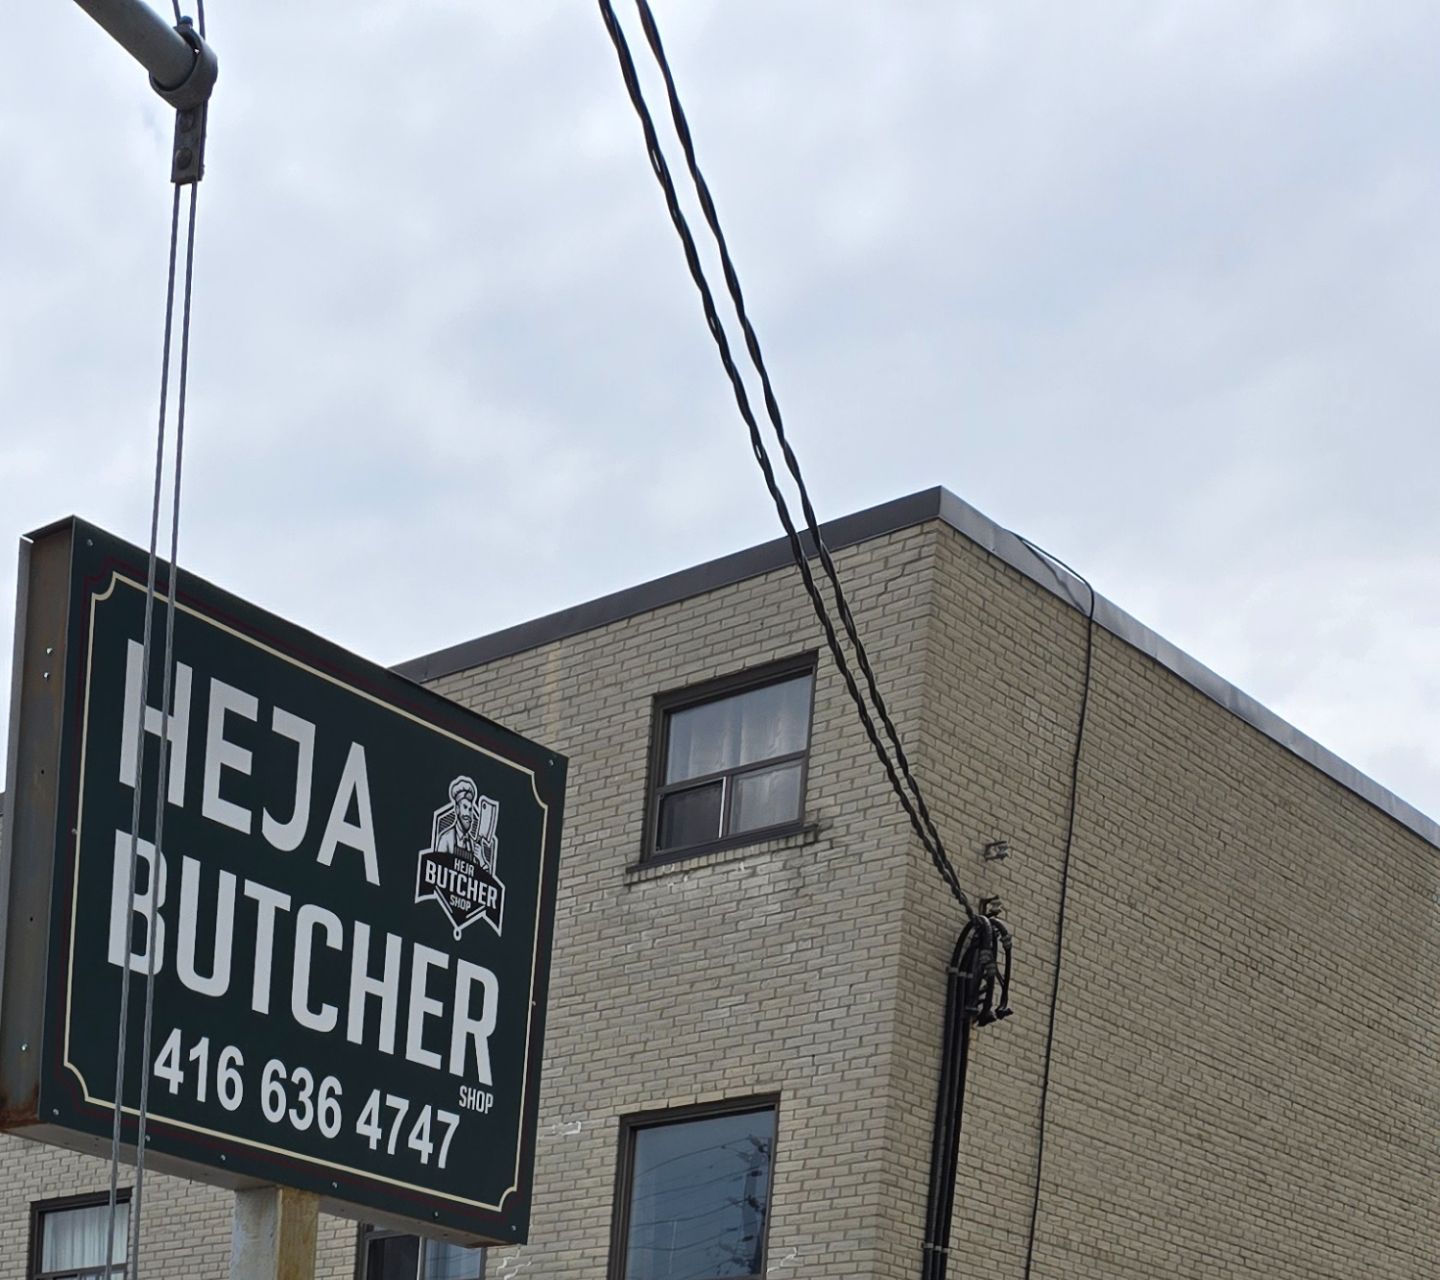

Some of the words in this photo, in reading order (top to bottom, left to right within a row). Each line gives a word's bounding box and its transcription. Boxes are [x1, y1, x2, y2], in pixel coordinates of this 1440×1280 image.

[119, 638, 381, 887] HEJA
[425, 860, 498, 909] BUTCHER
[450, 895, 471, 911] SHOP
[107, 829, 499, 1086] BUTCHER
[154, 1028, 245, 1111] 416
[261, 1059, 343, 1138] 636
[356, 1089, 460, 1169] 4747
[459, 1085, 494, 1114] SHOP
